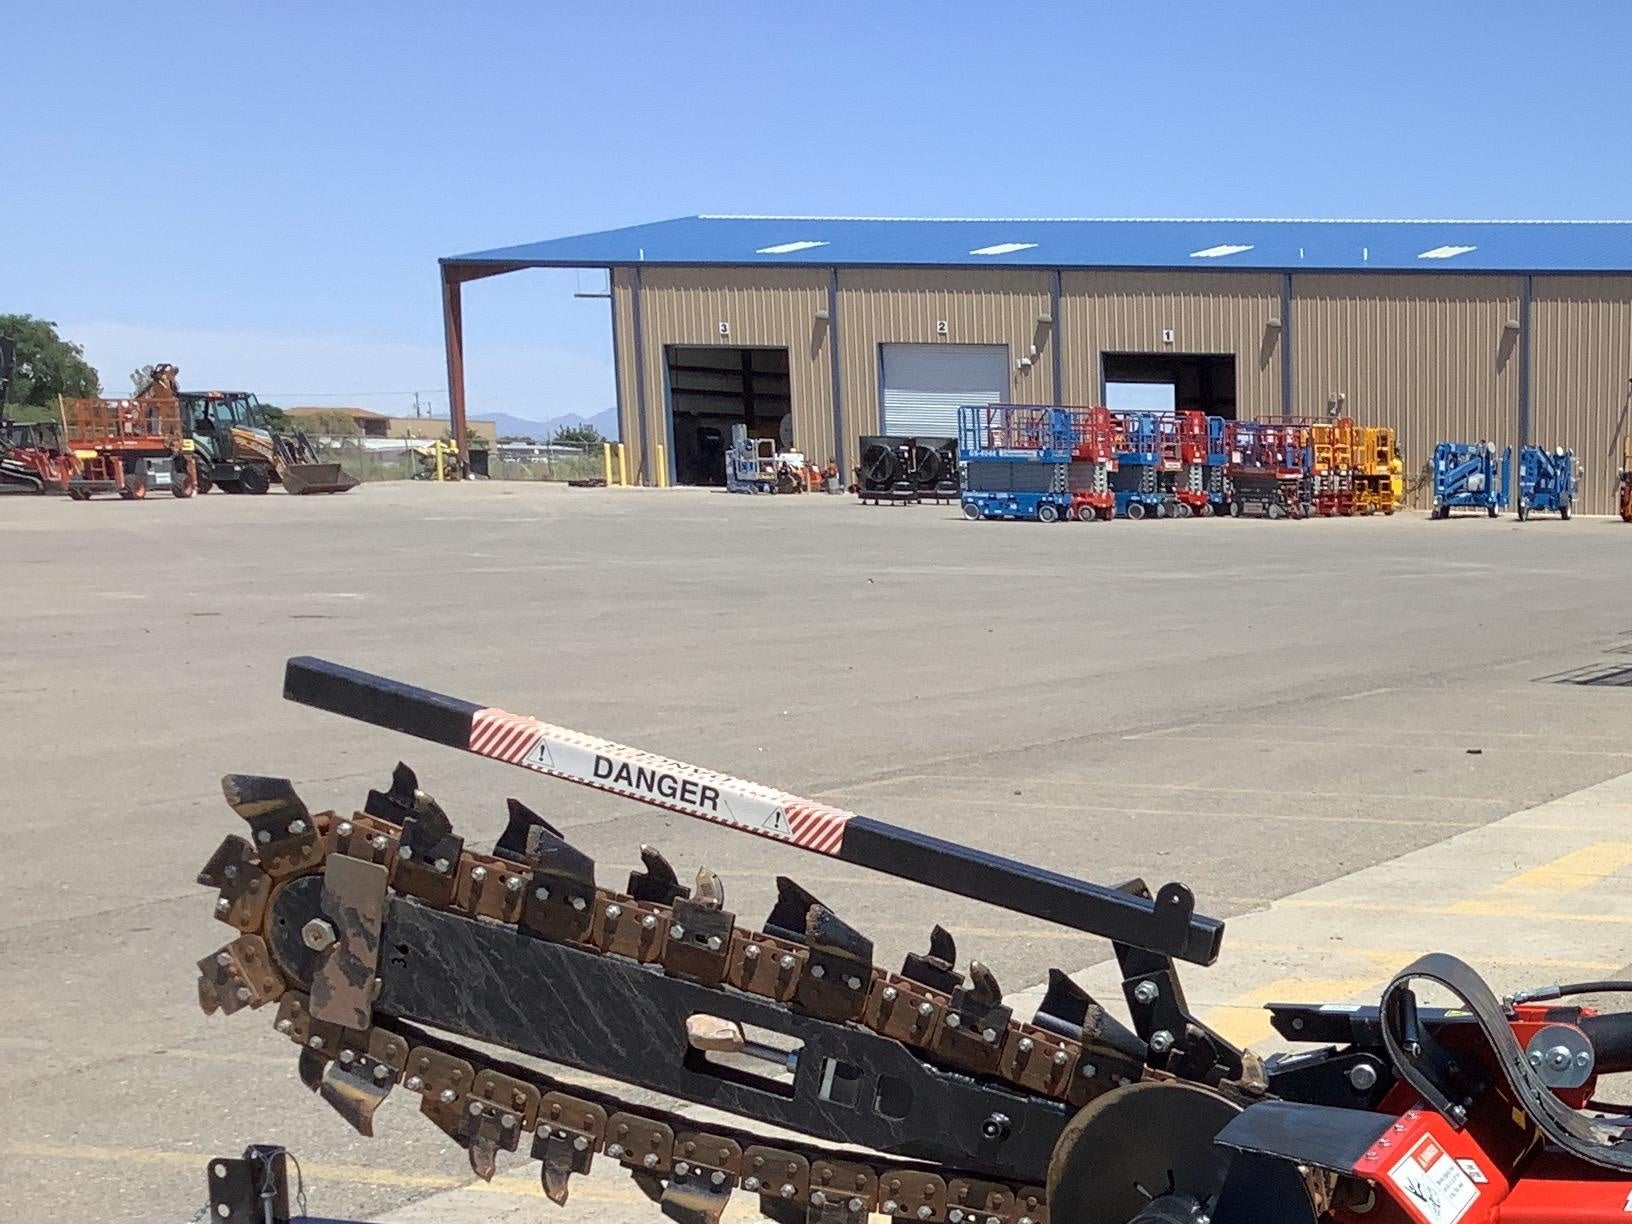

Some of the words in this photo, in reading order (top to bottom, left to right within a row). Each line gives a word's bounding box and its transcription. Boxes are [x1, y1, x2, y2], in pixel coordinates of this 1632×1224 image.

[720, 323, 728, 333] 3
[938, 322, 946, 332] 2
[593, 754, 720, 812] DANGER
